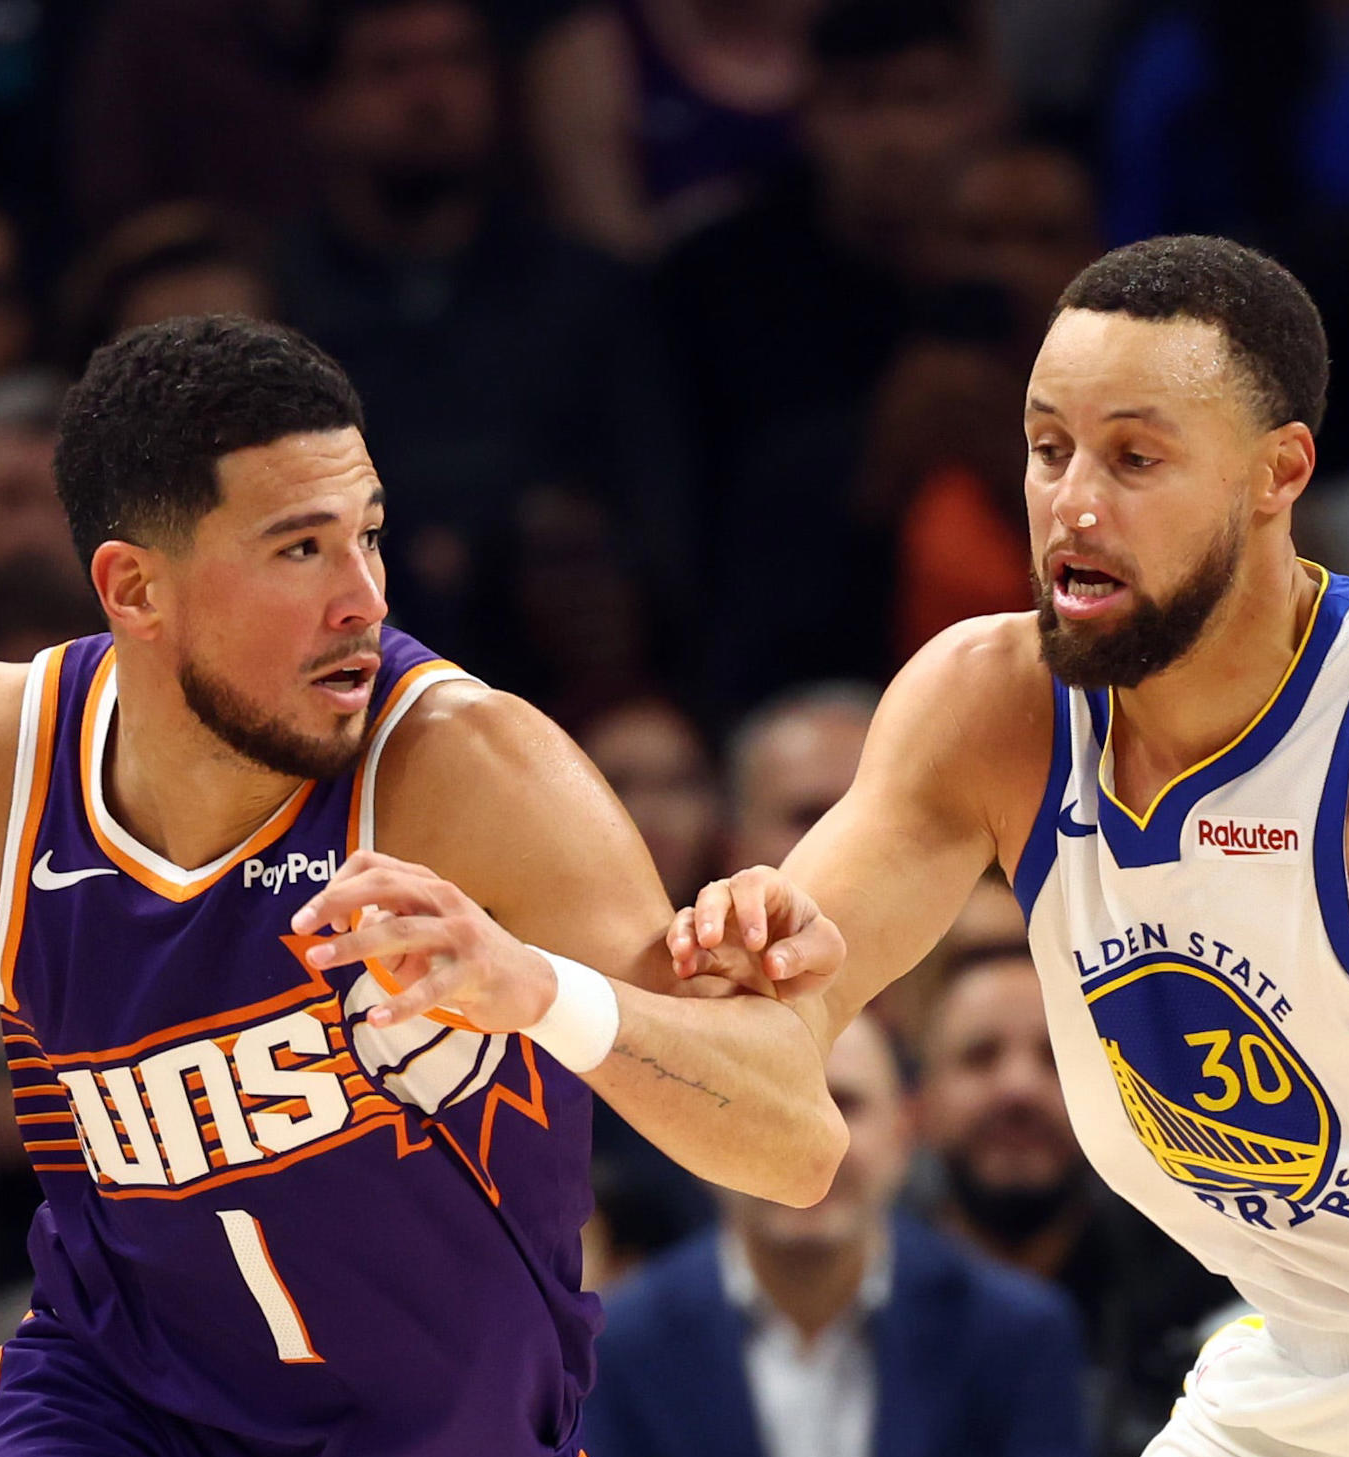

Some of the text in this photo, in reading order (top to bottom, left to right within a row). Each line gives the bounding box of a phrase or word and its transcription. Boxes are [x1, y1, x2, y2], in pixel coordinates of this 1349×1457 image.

[243, 849, 337, 895] PayPal
[1198, 819, 1299, 855] Rakuten
[1073, 922, 1293, 1023] LDEN STATE
[57, 1009, 351, 1186] UNS
[1183, 1029, 1292, 1112] 30
[215, 1209, 326, 1364] 1
